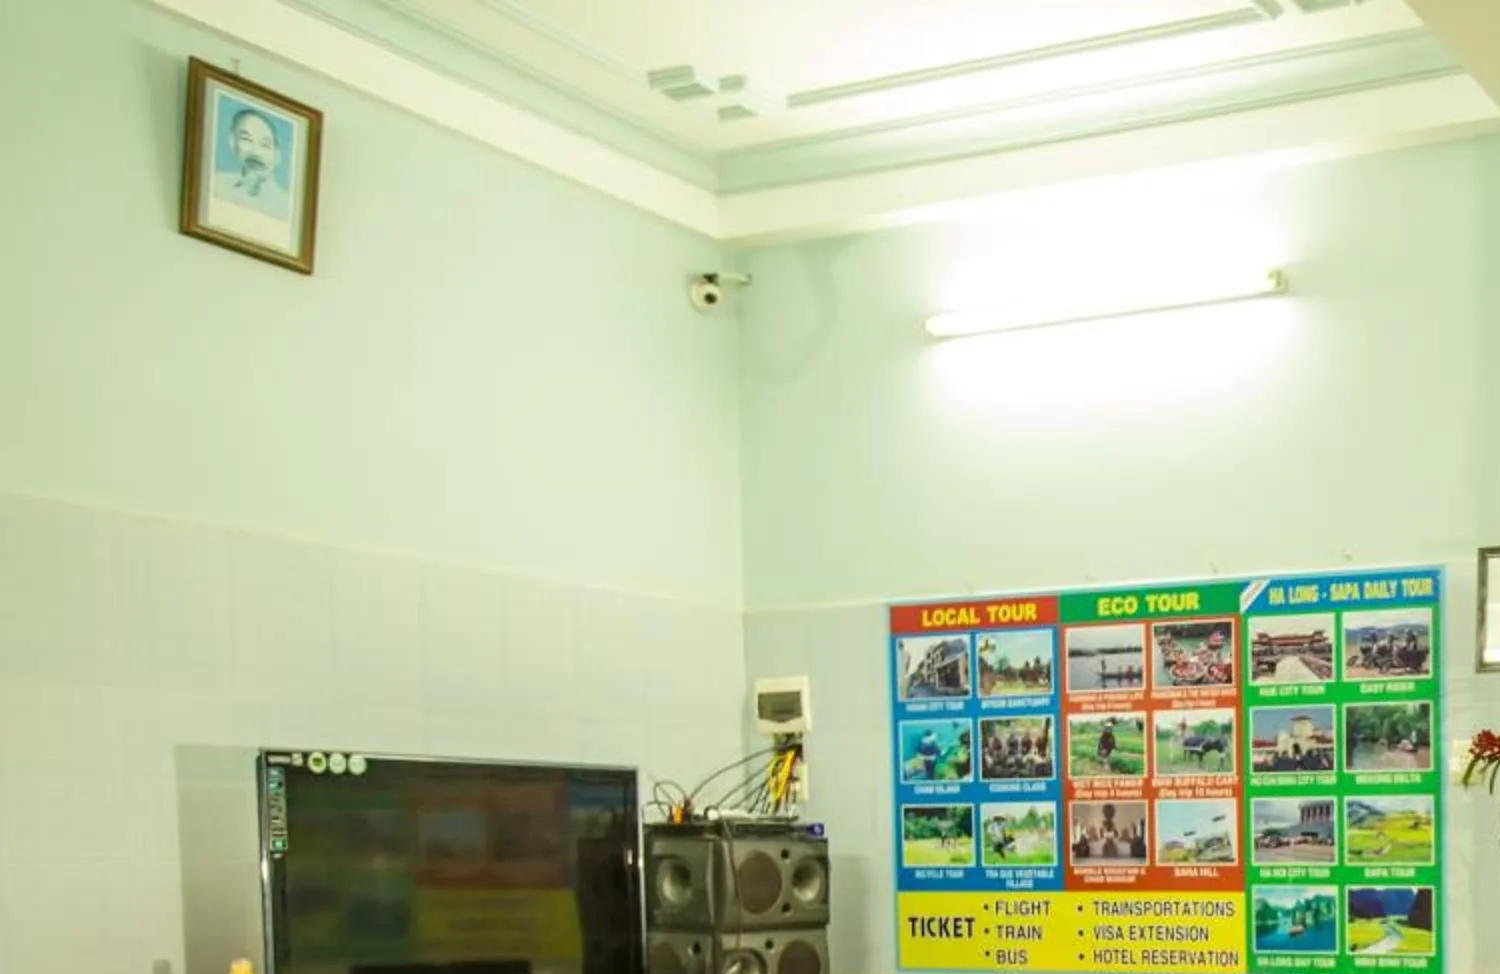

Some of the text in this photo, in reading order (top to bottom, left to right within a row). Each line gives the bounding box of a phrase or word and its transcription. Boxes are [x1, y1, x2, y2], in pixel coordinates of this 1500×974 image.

[1268, 587, 1285, 605] HA
[1289, 584, 1319, 605] LONG
[1330, 583, 1360, 601] SAPA
[1364, 580, 1398, 599] DAILY
[1402, 577, 1433, 598] TOUR
[1097, 592, 1199, 616] ECO TOUR
[921, 603, 1037, 627] LOCAL TOUR
[995, 901, 1051, 916] FLIGHT
[908, 917, 976, 938] TICKET
[996, 926, 1043, 941] TRAIN
[1093, 925, 1209, 942] VISA EXTENSION
[996, 950, 1028, 965] BUS
[1094, 950, 1239, 967] HOTEL RESERVATION
